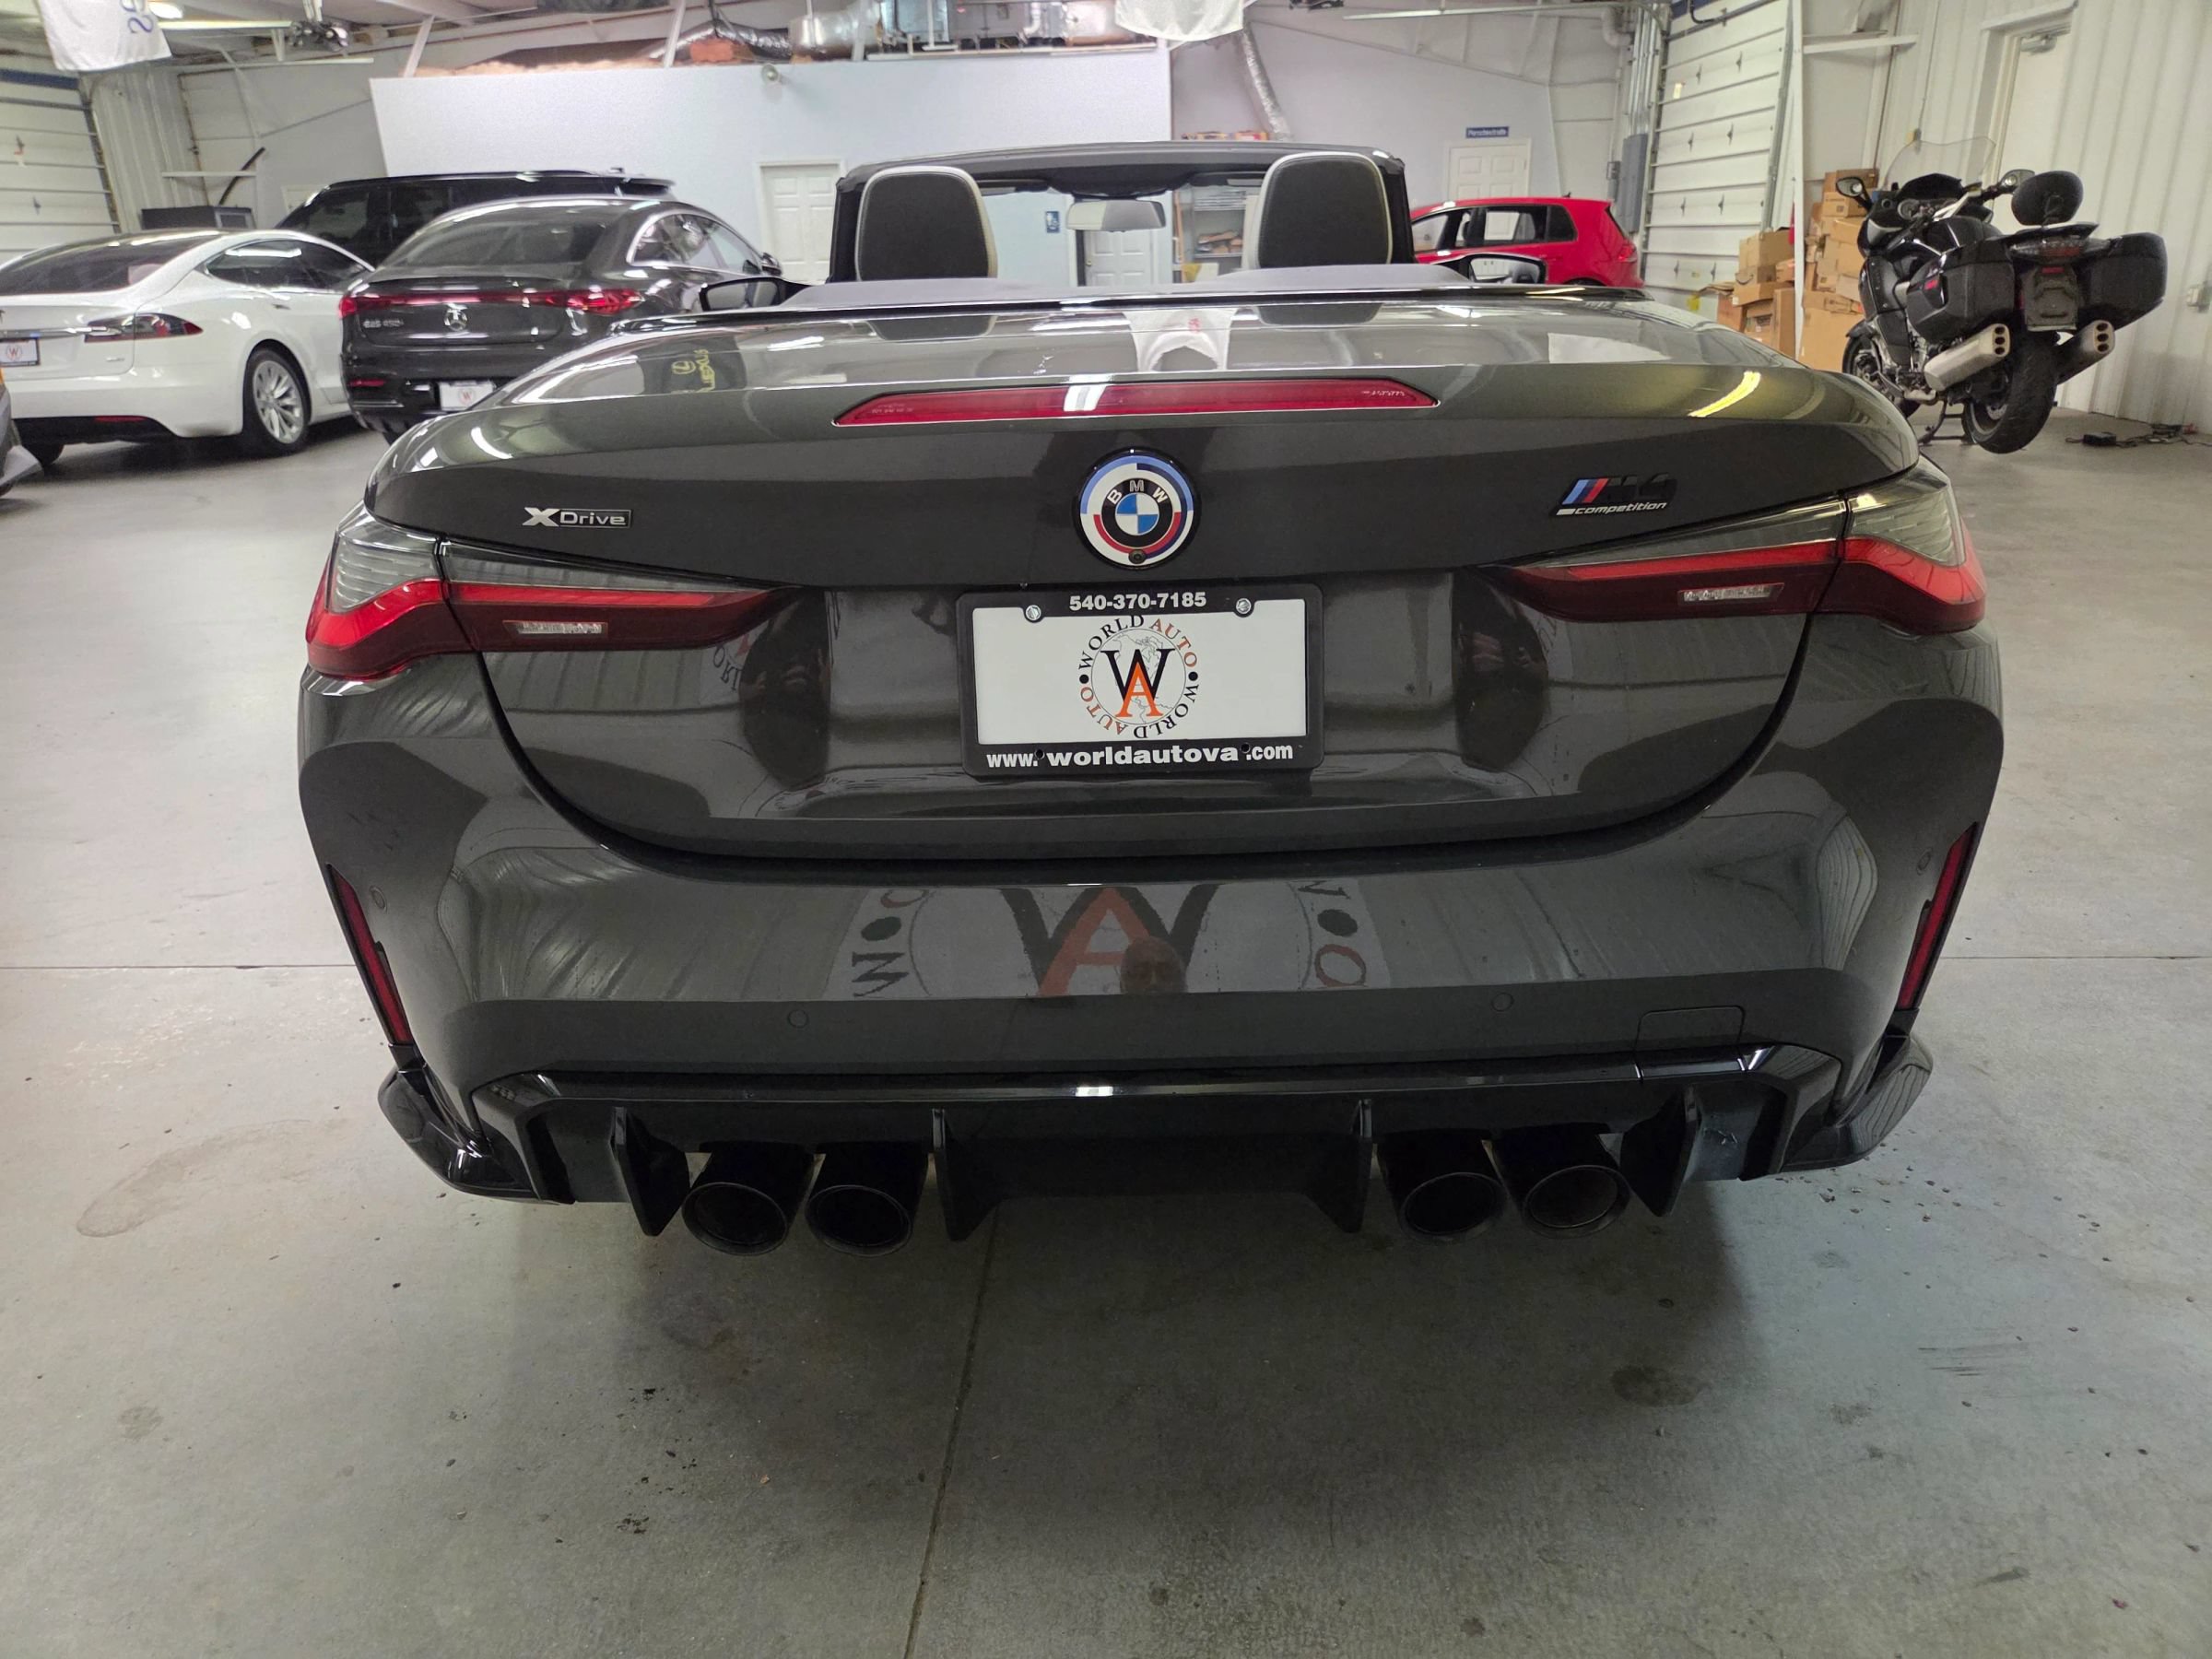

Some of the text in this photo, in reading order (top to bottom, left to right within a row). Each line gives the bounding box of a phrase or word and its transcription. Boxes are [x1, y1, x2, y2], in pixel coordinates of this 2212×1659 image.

[1107, 479, 1168, 504] BMW
[1574, 502, 1667, 515] competition
[1069, 592, 1207, 611] 540-370-7185
[1078, 615, 1197, 670] WORLD AUTO
[1080, 685, 1199, 739] WORLD AUTO
